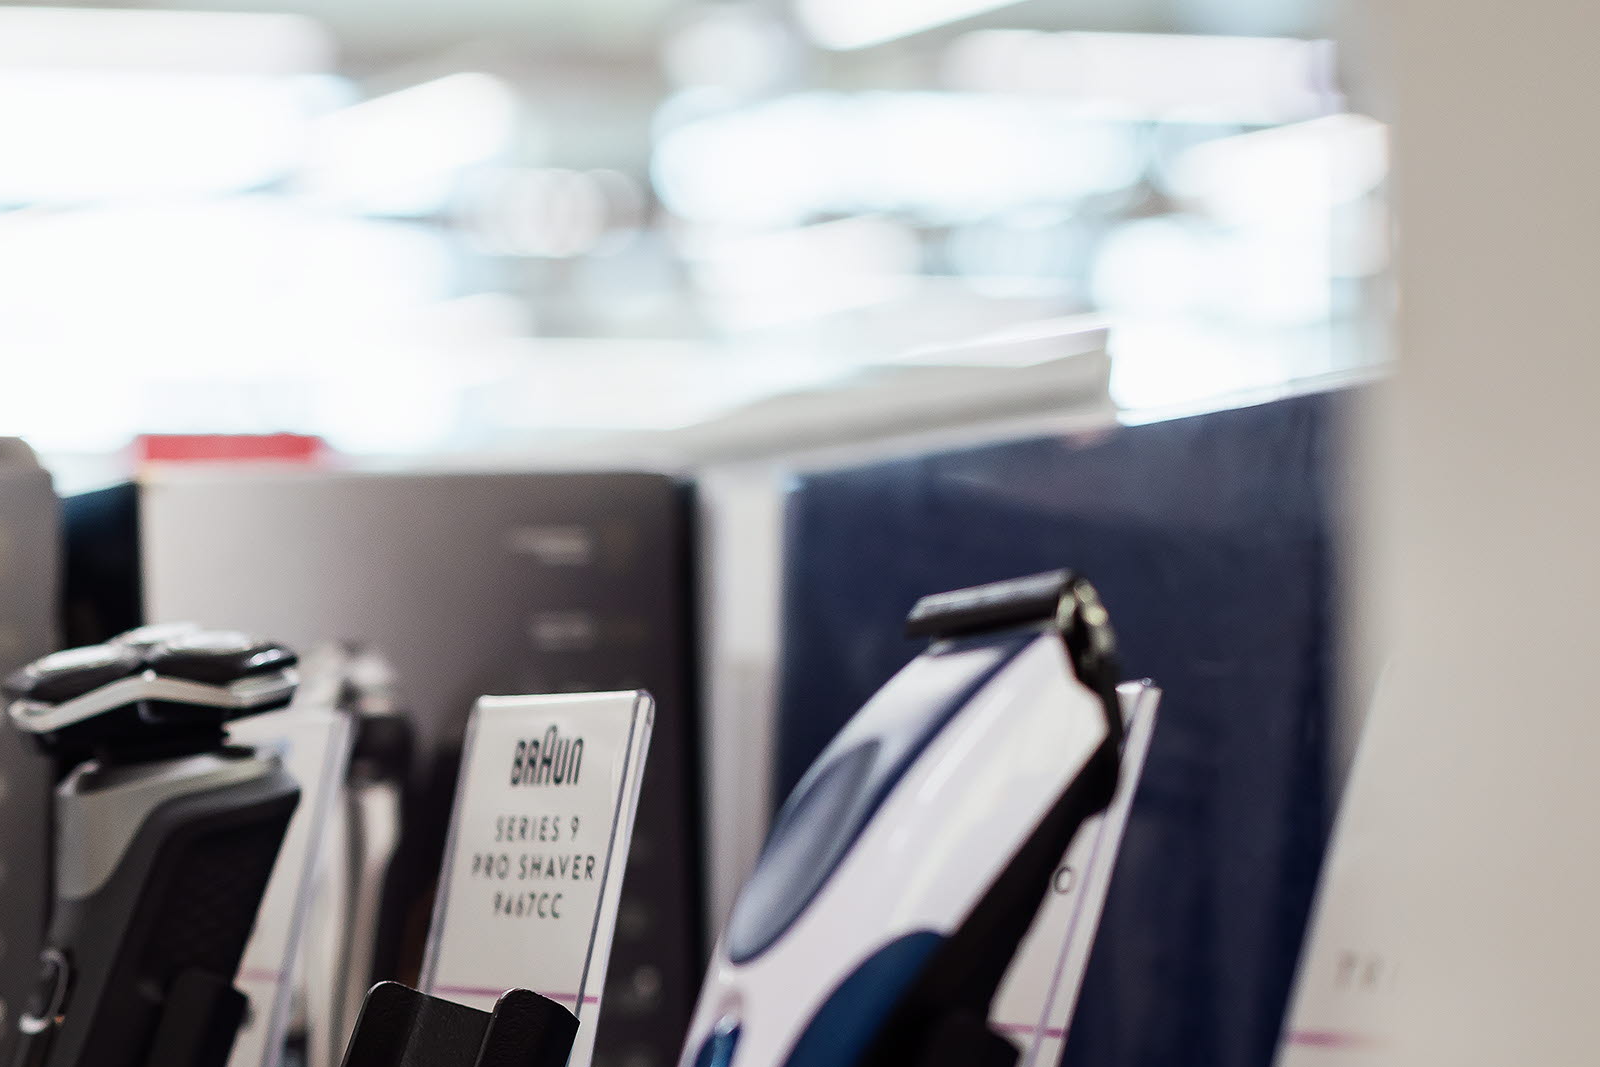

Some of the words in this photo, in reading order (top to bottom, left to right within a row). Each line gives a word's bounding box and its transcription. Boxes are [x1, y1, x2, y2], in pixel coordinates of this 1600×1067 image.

[510, 724, 584, 787] BRAUN
[494, 815, 561, 842] SERIES
[569, 816, 580, 843] 9
[471, 853, 510, 880] PRO
[517, 855, 597, 881] SHAVER
[492, 891, 563, 919] 9467CC
